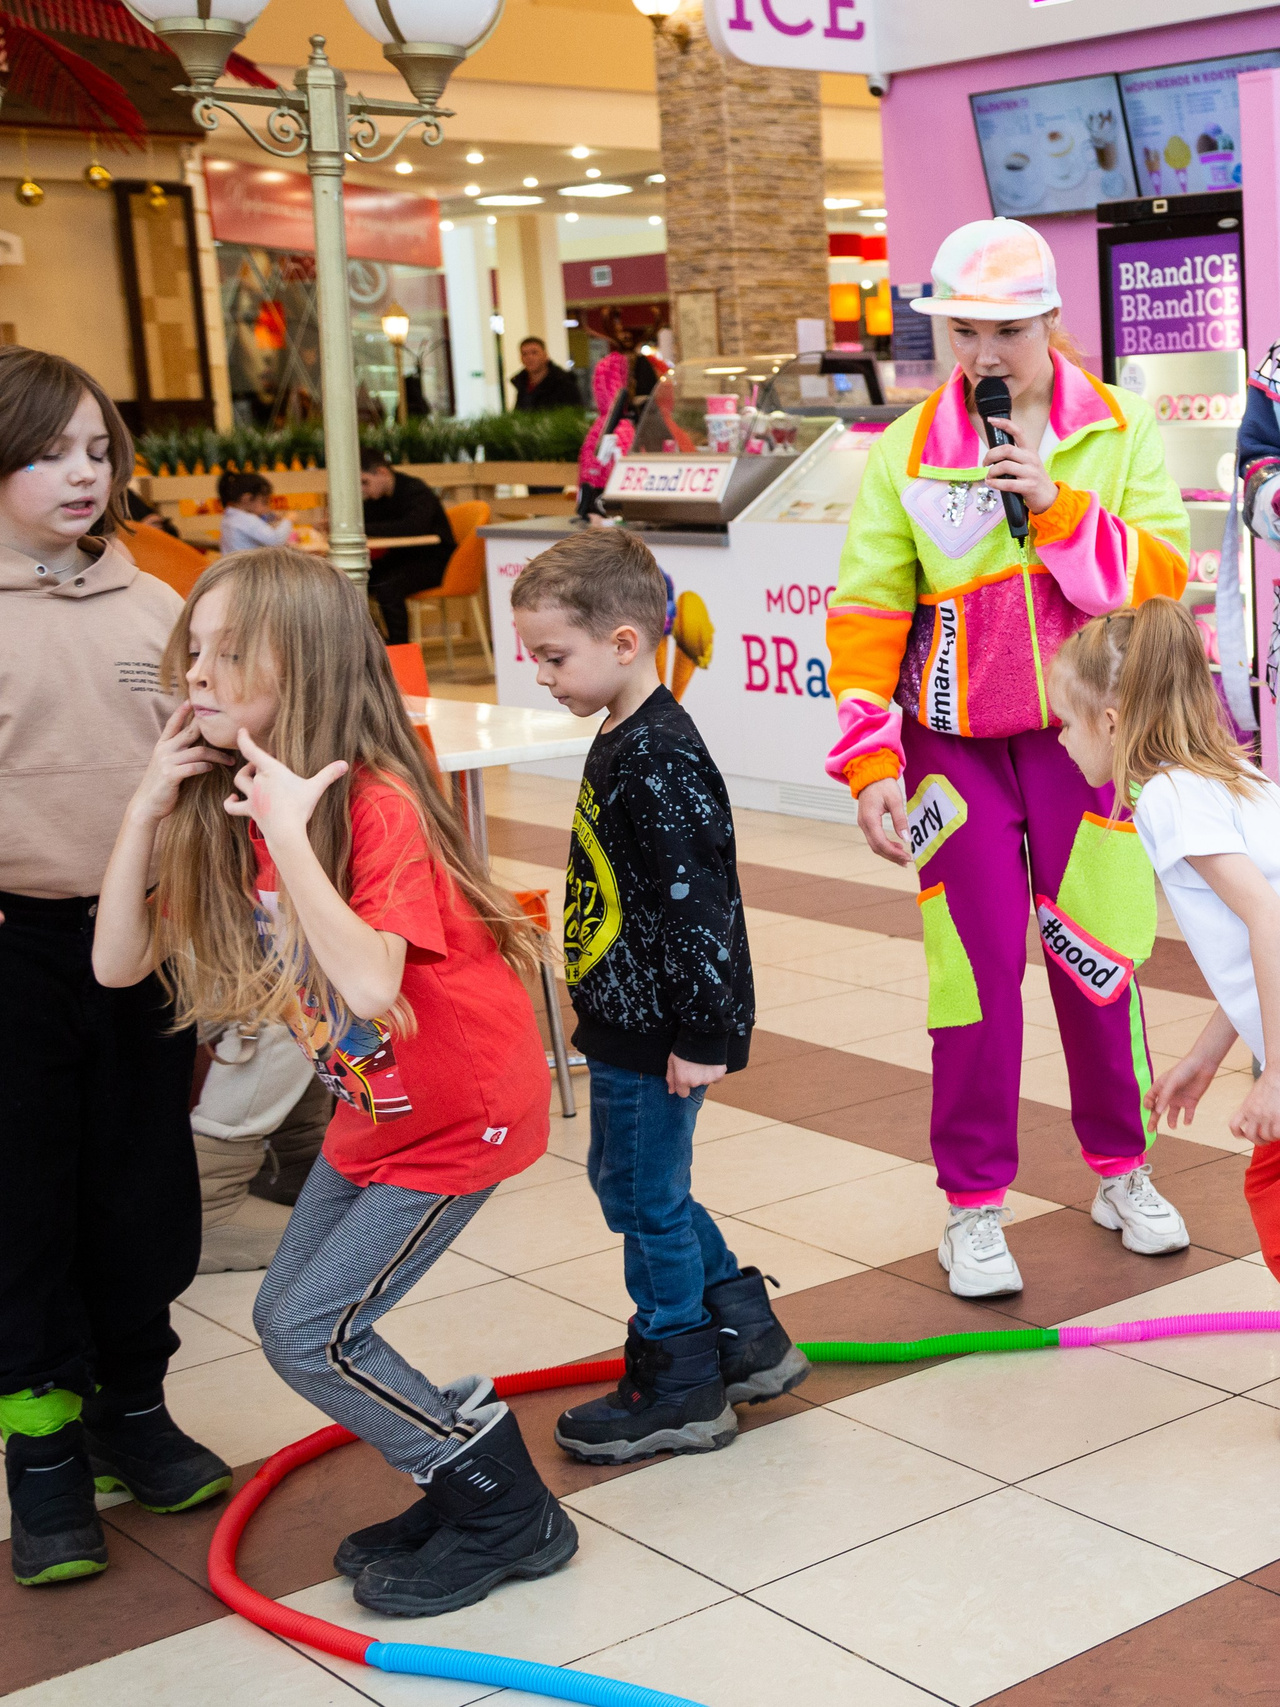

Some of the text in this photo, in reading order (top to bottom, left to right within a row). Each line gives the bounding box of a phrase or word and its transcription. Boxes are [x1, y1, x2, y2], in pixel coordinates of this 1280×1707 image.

[1119, 253, 1239, 291] BRandICE
[1120, 286, 1240, 322] BRandICE
[1122, 319, 1241, 353] BRandICE
[620, 466, 720, 493] BRandICE
[1041, 917, 1119, 989] #good
